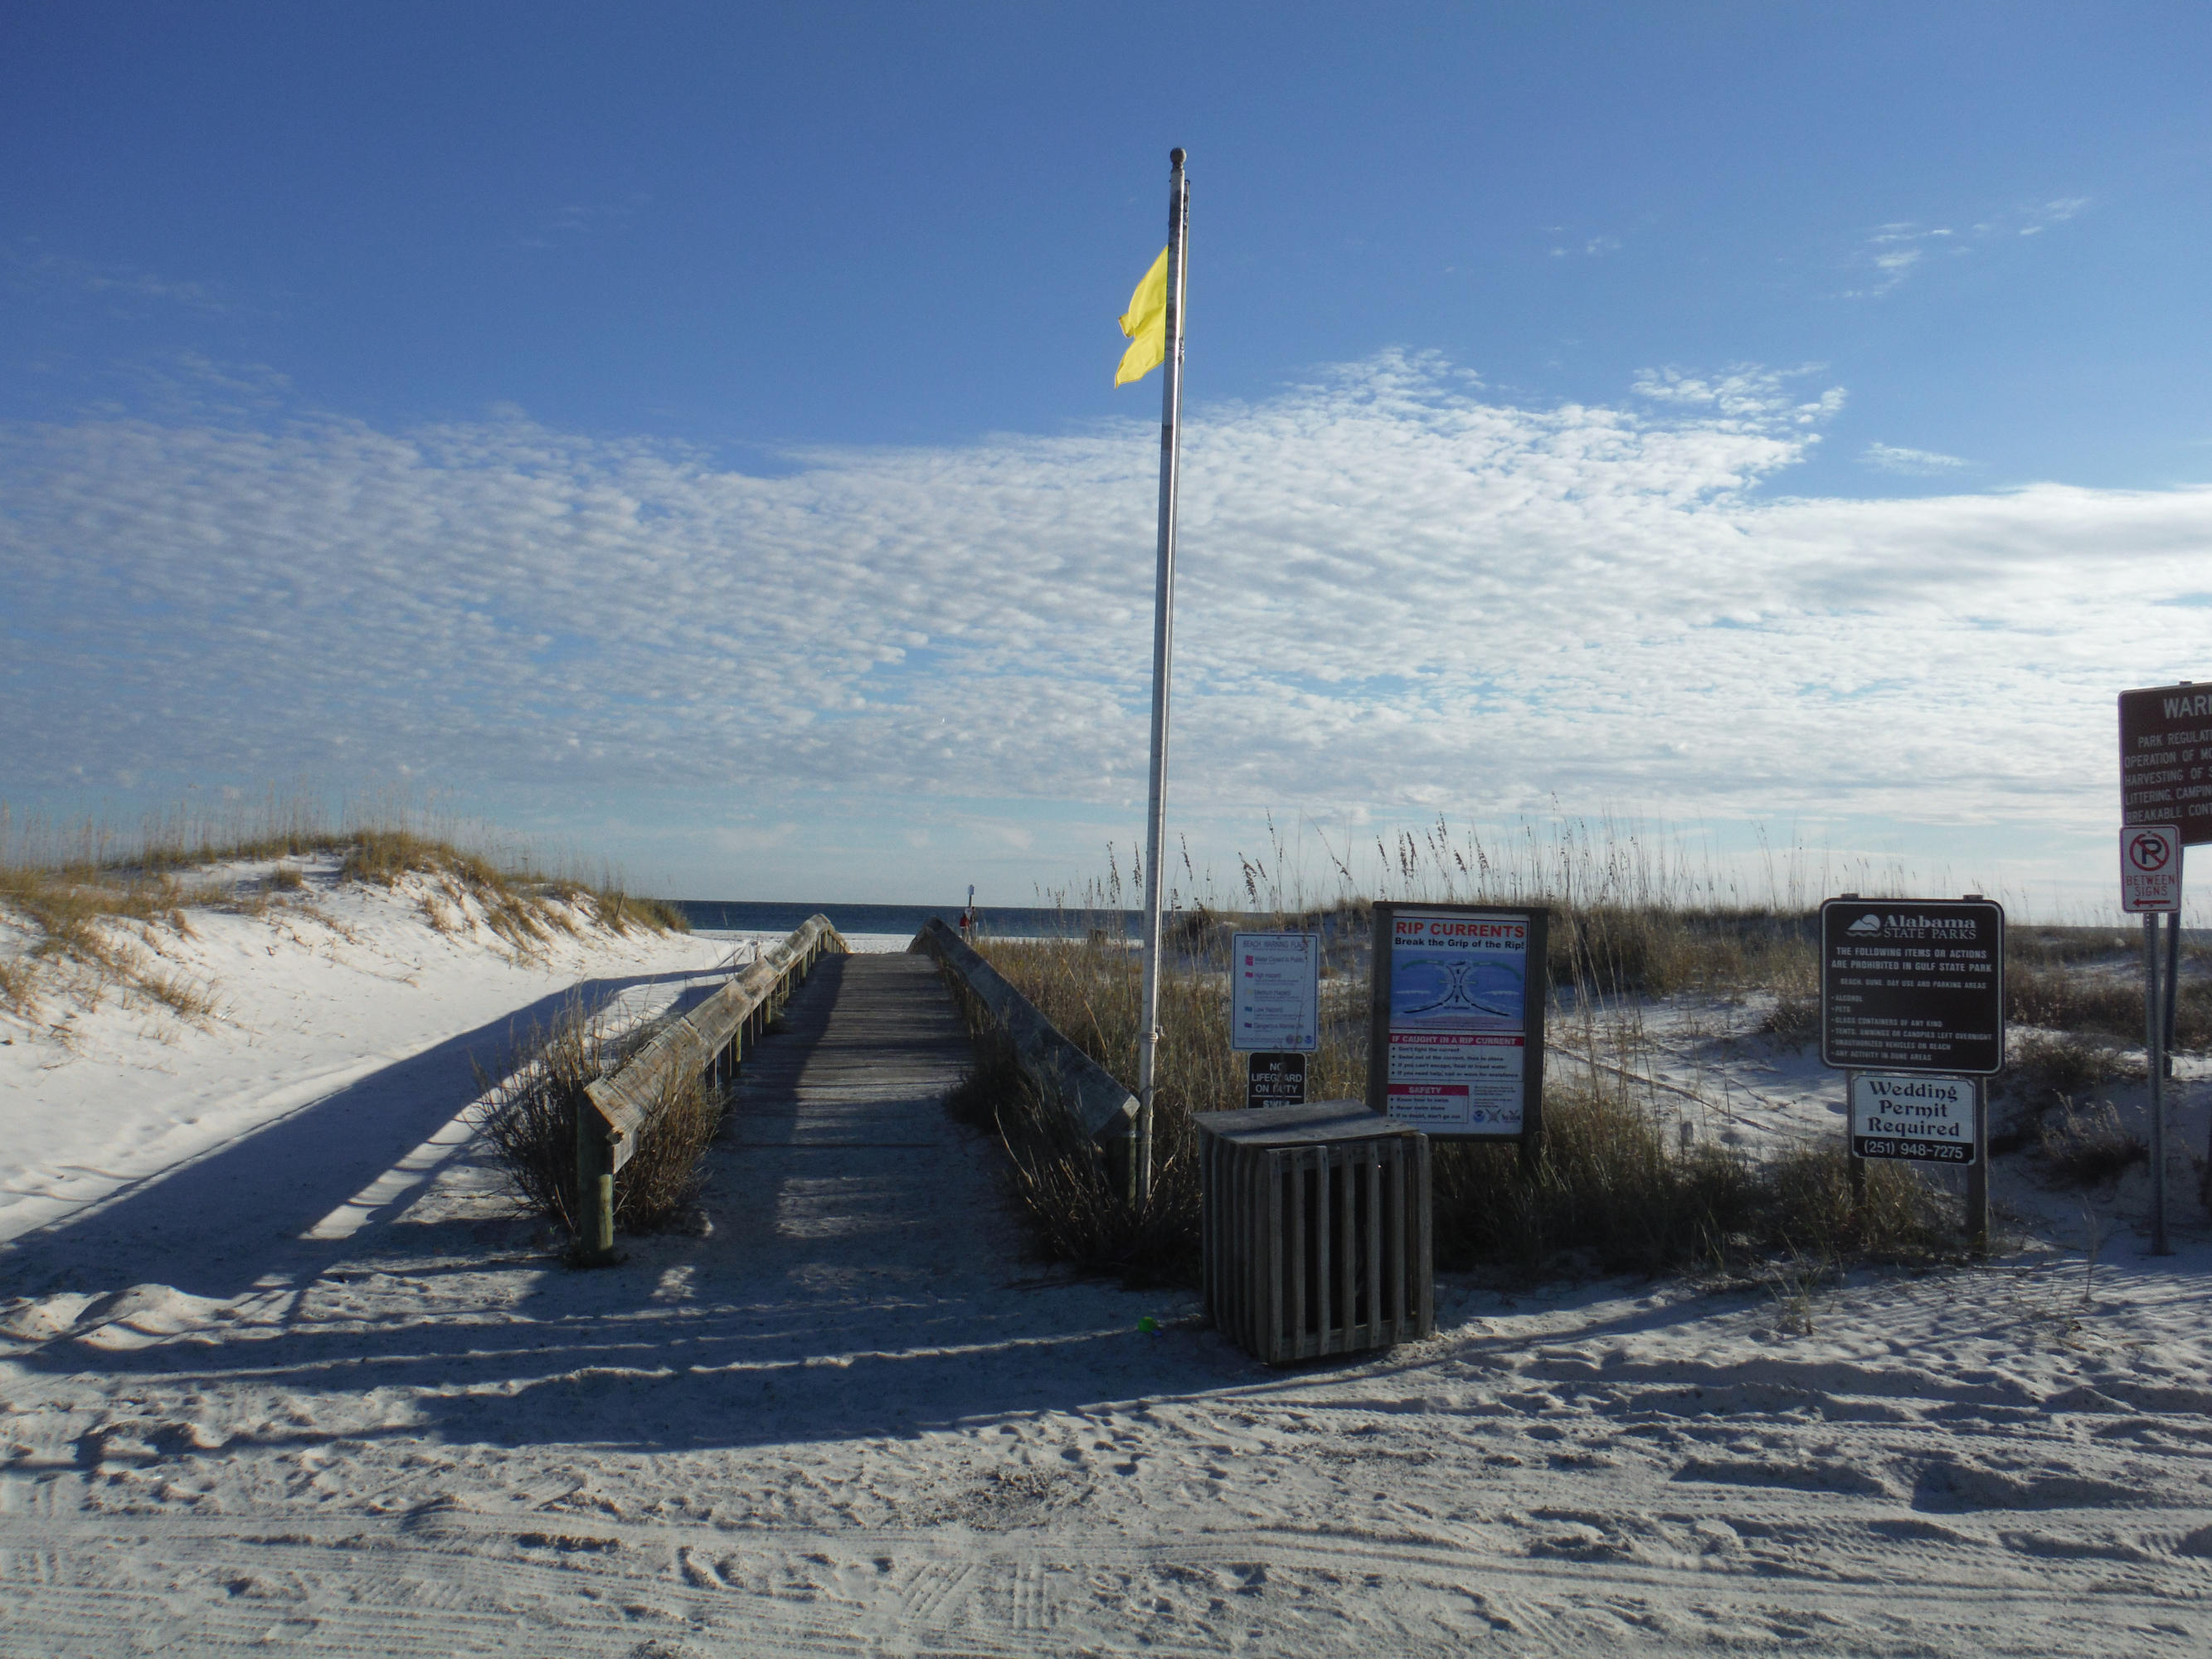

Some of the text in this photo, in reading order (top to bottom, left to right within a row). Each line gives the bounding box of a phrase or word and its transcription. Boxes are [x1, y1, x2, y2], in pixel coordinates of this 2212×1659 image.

[2163, 693, 2212, 719] WAR
[2138, 734, 2163, 747] PARK
[2125, 752, 2176, 768] OPERATION
[2182, 749, 2195, 762] OF
[2125, 769, 2183, 787] HARVESTING
[2190, 766, 2204, 780] OF
[2127, 805, 2183, 824] BREAKABLE
[2127, 874, 2175, 886] BETWEEN
[2135, 886, 2168, 897] SIGNS
[1884, 915, 1976, 928] Alabama
[1396, 922, 1524, 938] RIP CURRENTS
[1884, 928, 1976, 940] STATE PARKS
[1395, 938, 1524, 951] Break the Grip of the Rip!
[1836, 946, 1986, 959] THE FOLLOWING ITEMS OR ACTIONS
[1831, 960, 1991, 972] ARE PROHIBITED IN GULF STATE PARK
[1932, 980, 1961, 989] PARKING
[1403, 1035, 1437, 1044] CAUGHT
[1252, 1073, 1302, 1082] LIFEGARD
[1256, 1083, 1269, 1093] ON
[1869, 1082, 1958, 1102] Wedding
[1879, 1100, 1948, 1118] Permit
[1868, 1117, 1960, 1136] Required
[1864, 1140, 1964, 1160] (251) 948-7275
